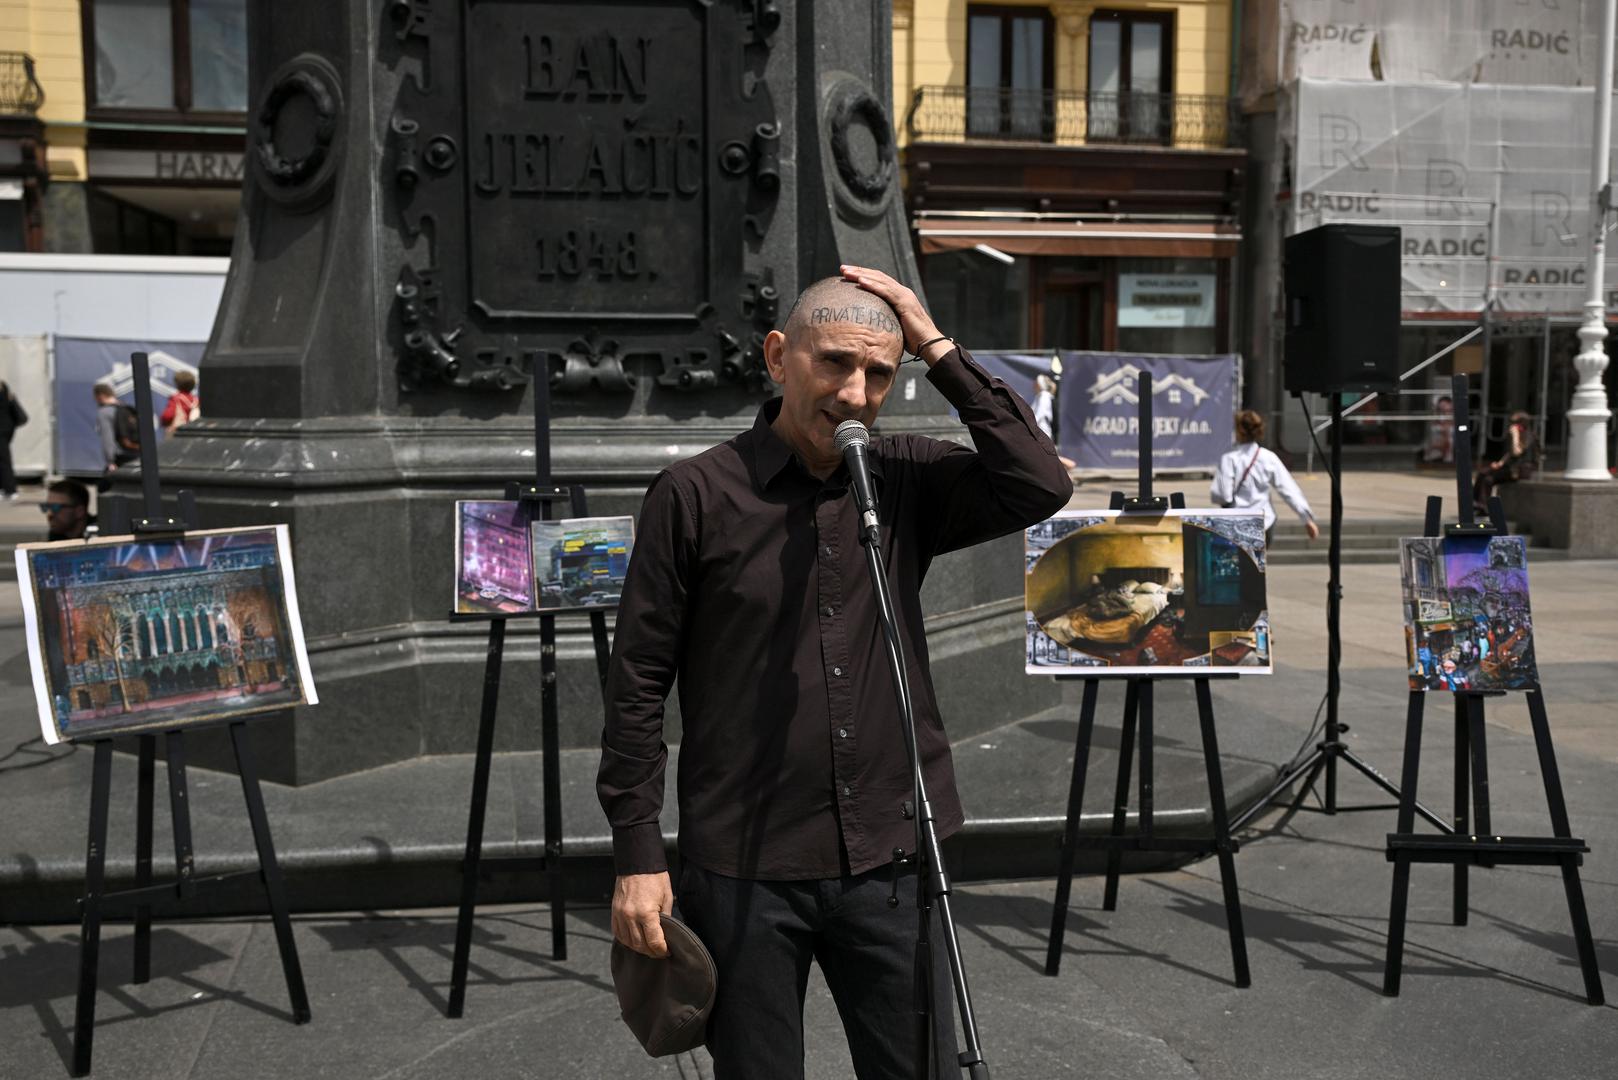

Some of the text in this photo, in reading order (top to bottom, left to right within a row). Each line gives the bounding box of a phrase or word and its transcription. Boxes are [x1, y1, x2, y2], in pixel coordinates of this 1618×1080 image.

[1290, 21, 1367, 45] RADIĆ
[1491, 28, 1570, 55] RADIĆ
[523, 34, 652, 103] BAN
[1318, 113, 1370, 172] R
[474, 117, 702, 201] JELAČIĆ
[1300, 189, 1380, 214] RADIĆ
[1529, 190, 1578, 248] R
[1403, 232, 1487, 257] RADIĆ
[1504, 263, 1586, 285] RADIĆ
[810, 305, 866, 326] PRIVATE
[1083, 415, 1128, 435] AGRAD
